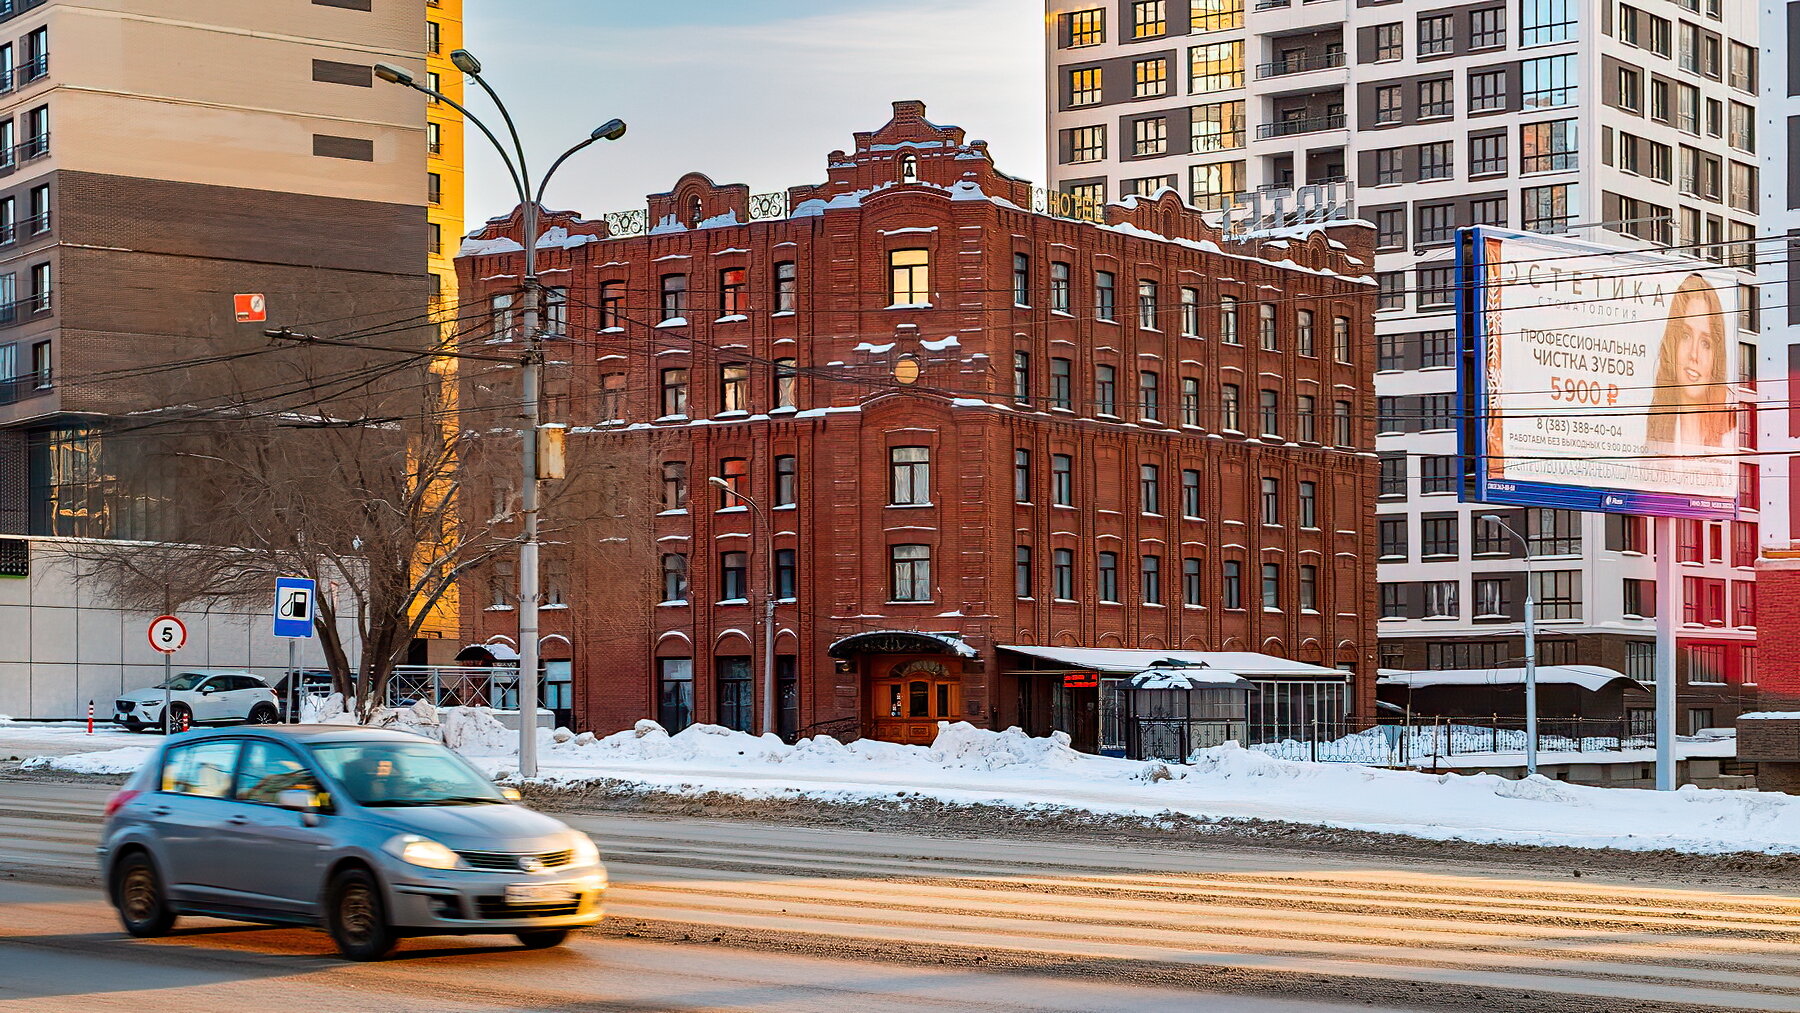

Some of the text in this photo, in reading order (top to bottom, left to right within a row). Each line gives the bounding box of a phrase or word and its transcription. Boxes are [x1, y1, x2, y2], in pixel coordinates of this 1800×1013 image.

[1047, 189, 1105, 224] HOTEL
[1505, 261, 1665, 307] ЭСТЕТИКА
[1520, 328, 1646, 358] ПРОФЕССИОНАЛЬНАЯ
[1533, 348, 1635, 377] ЧИСТКА ЗУБОВ
[1550, 376, 1601, 405] 5900
[1536, 417, 1622, 437] 8 (383) 388-40-04
[1509, 432, 1546, 445] РАБОТАЕМ
[1547, 437, 1560, 446] БЕЗ
[1561, 438, 1601, 450] ВЫХОДНЫХ
[1621, 443, 1632, 454] ДО
[161, 626, 173, 643] 5
